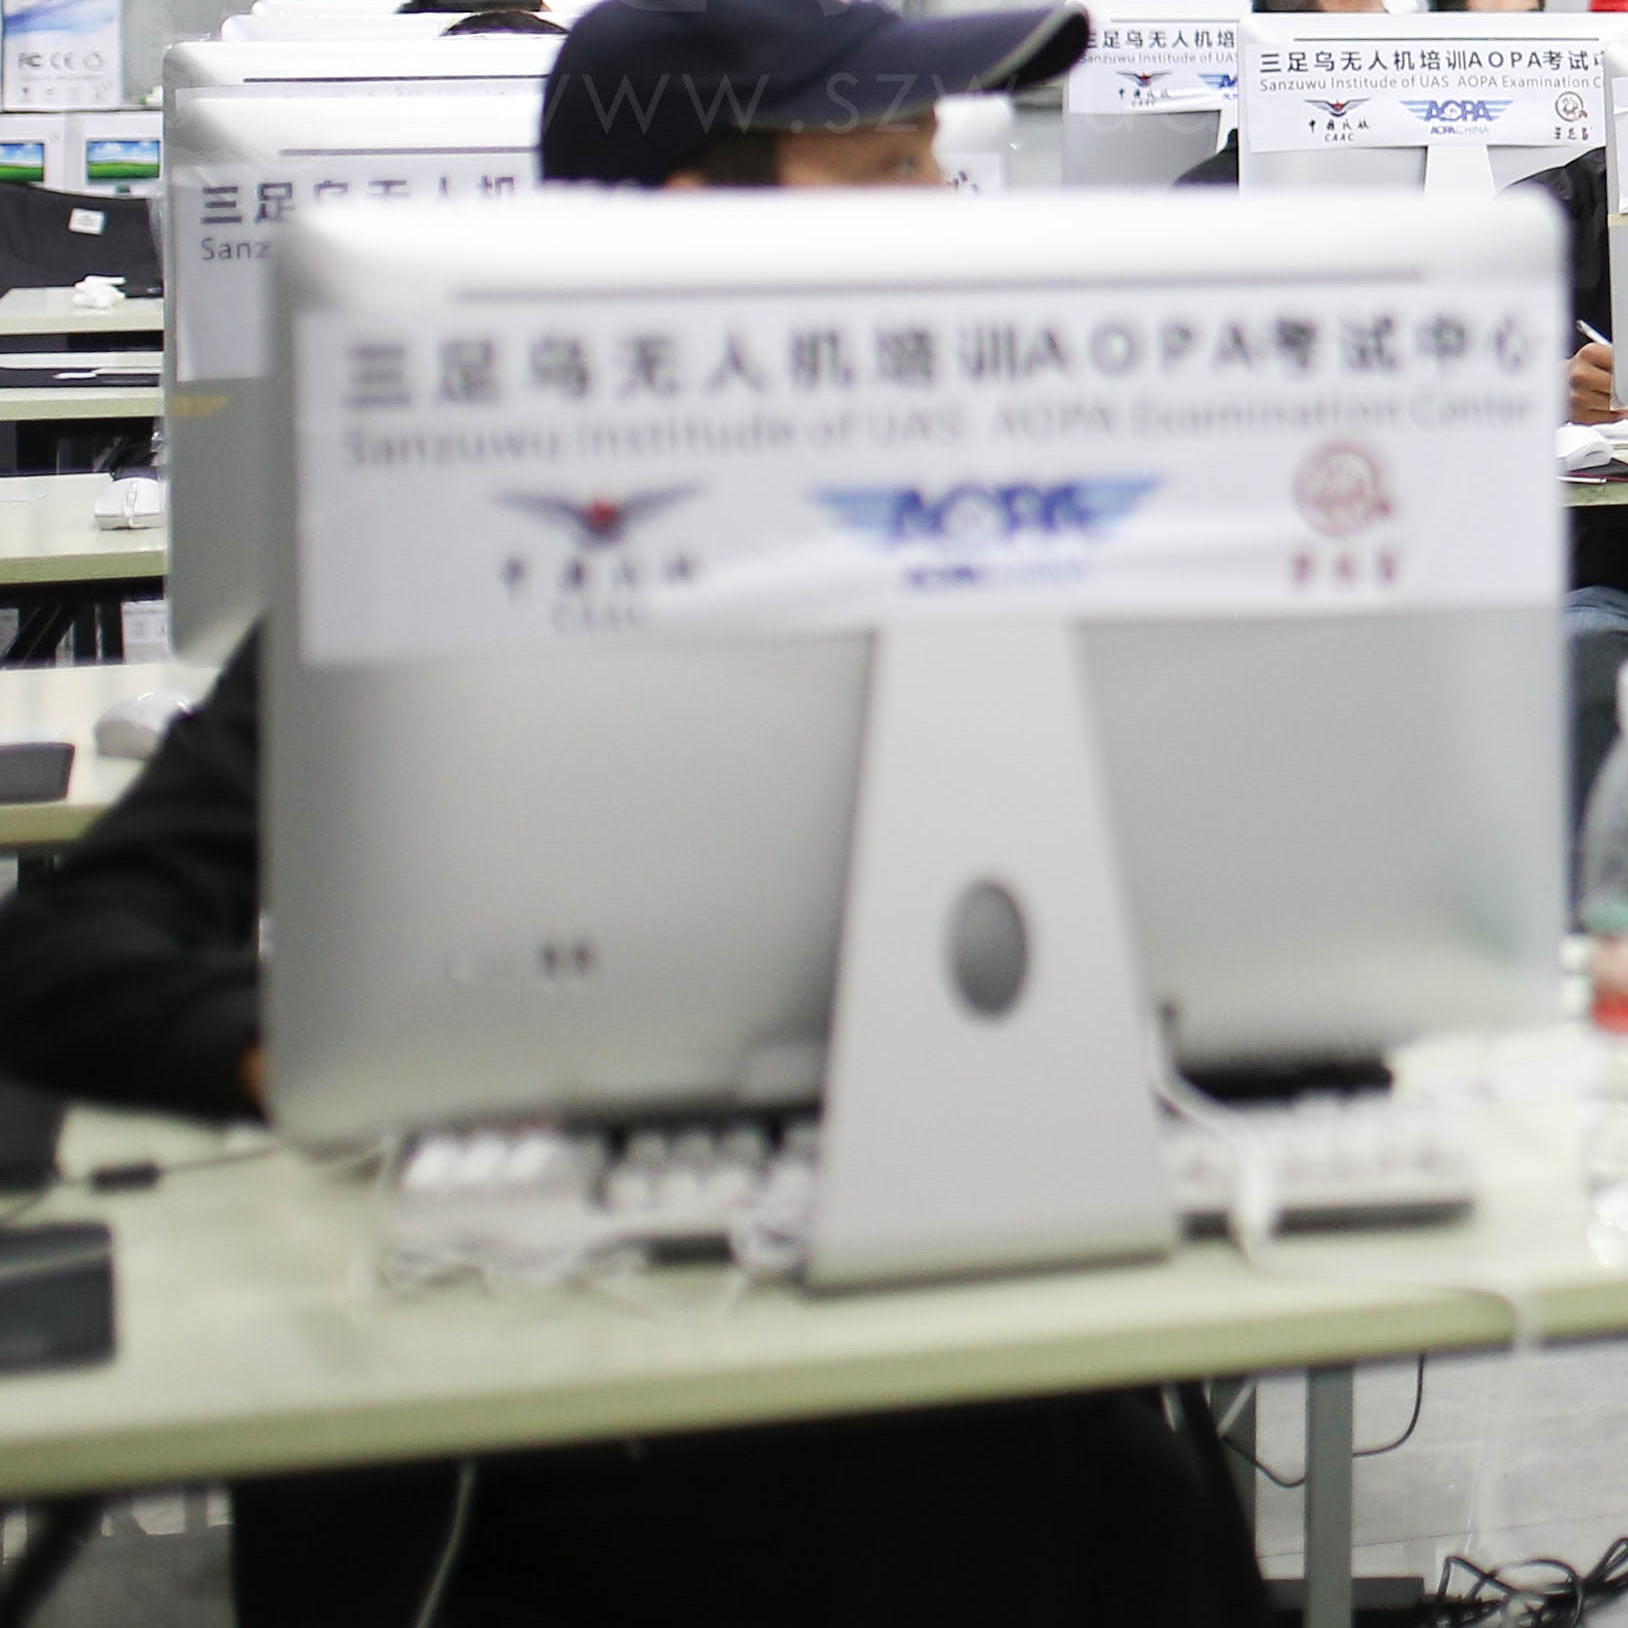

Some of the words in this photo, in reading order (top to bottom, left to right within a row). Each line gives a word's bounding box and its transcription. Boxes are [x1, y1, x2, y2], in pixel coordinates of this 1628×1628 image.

[1259, 77, 1326, 93] Sanzuwu
[1330, 75, 1398, 90] Institude
[1401, 75, 1417, 89] of
[1420, 76, 1450, 89] UAS
[1457, 75, 1498, 89] AOPA
[1502, 75, 1589, 89] Examination
